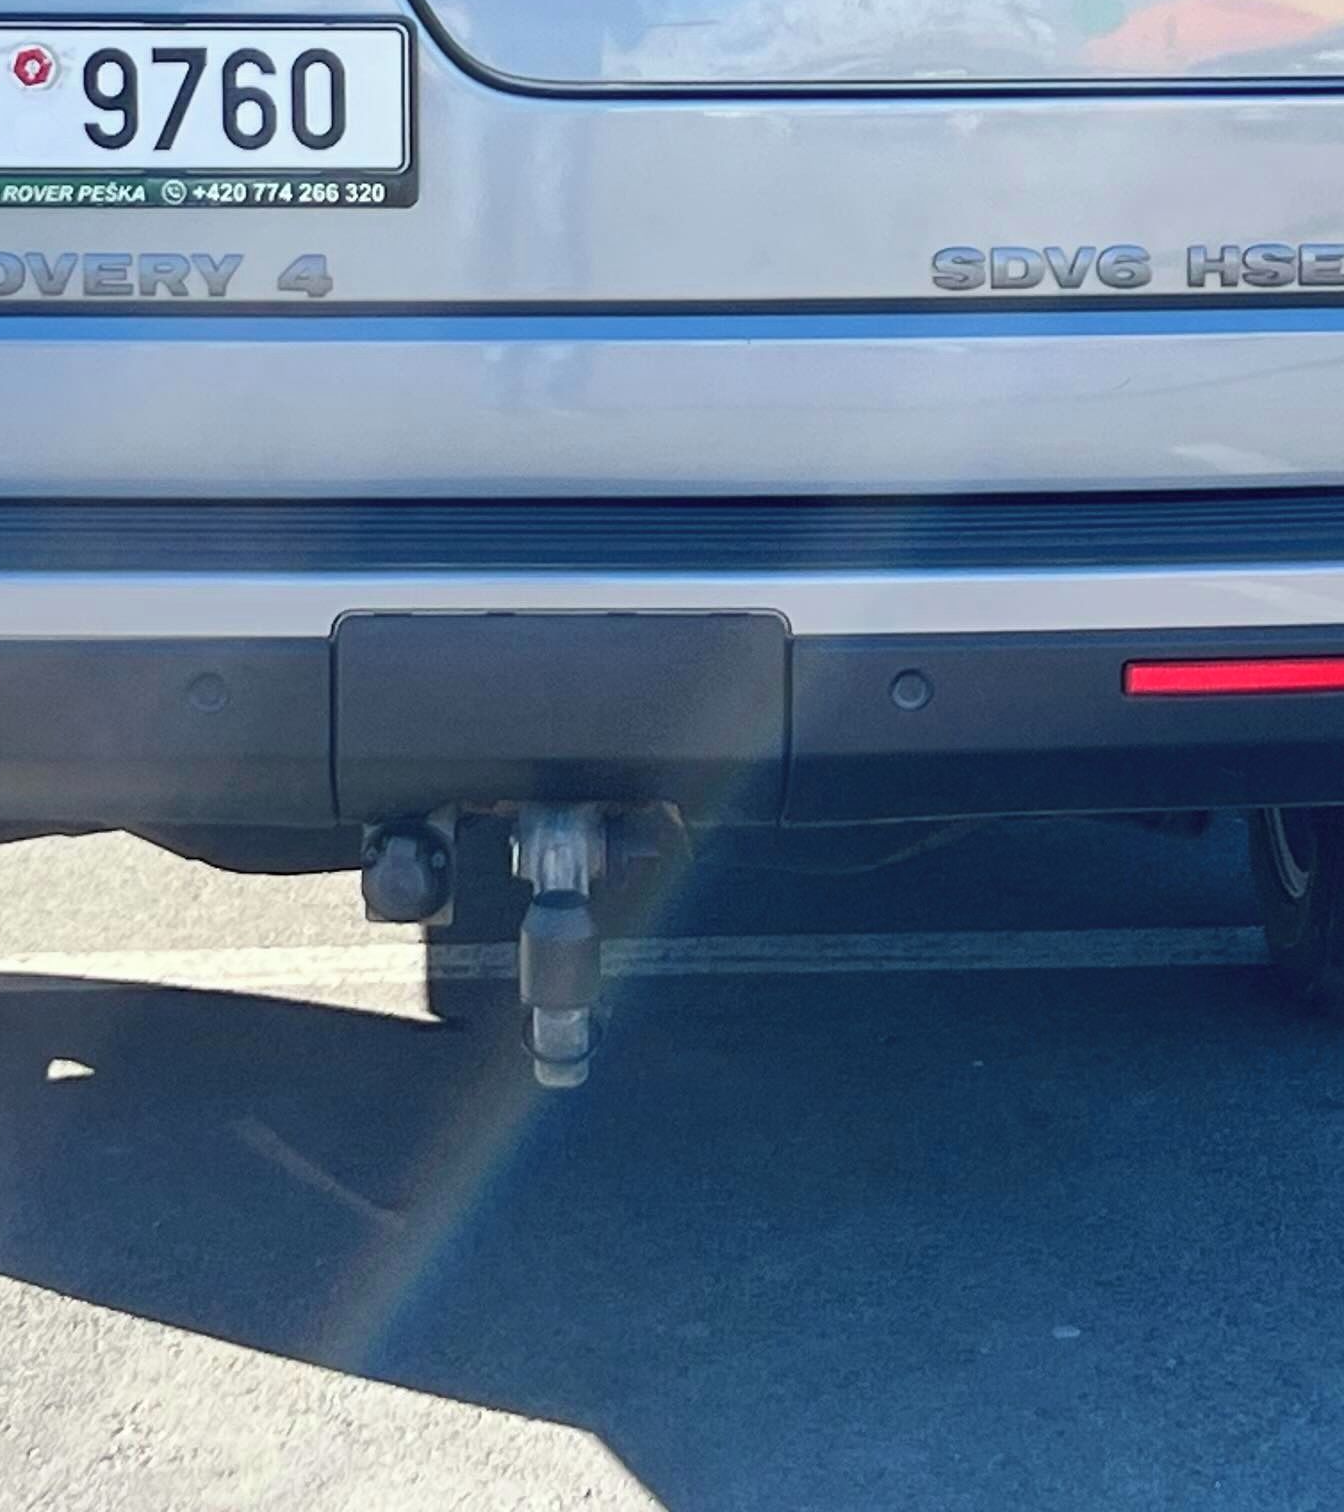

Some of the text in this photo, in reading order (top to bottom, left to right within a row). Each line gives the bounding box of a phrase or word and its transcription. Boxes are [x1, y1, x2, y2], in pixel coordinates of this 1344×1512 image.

[82, 46, 348, 152] 9760
[2, 183, 73, 203] ROVER
[76, 180, 147, 203] PEŠKA
[191, 182, 248, 204] +420
[252, 182, 294, 204] 774
[298, 182, 341, 204] 266
[344, 182, 386, 204] 320
[275, 253, 335, 300] 4
[930, 244, 1154, 291] SDV6
